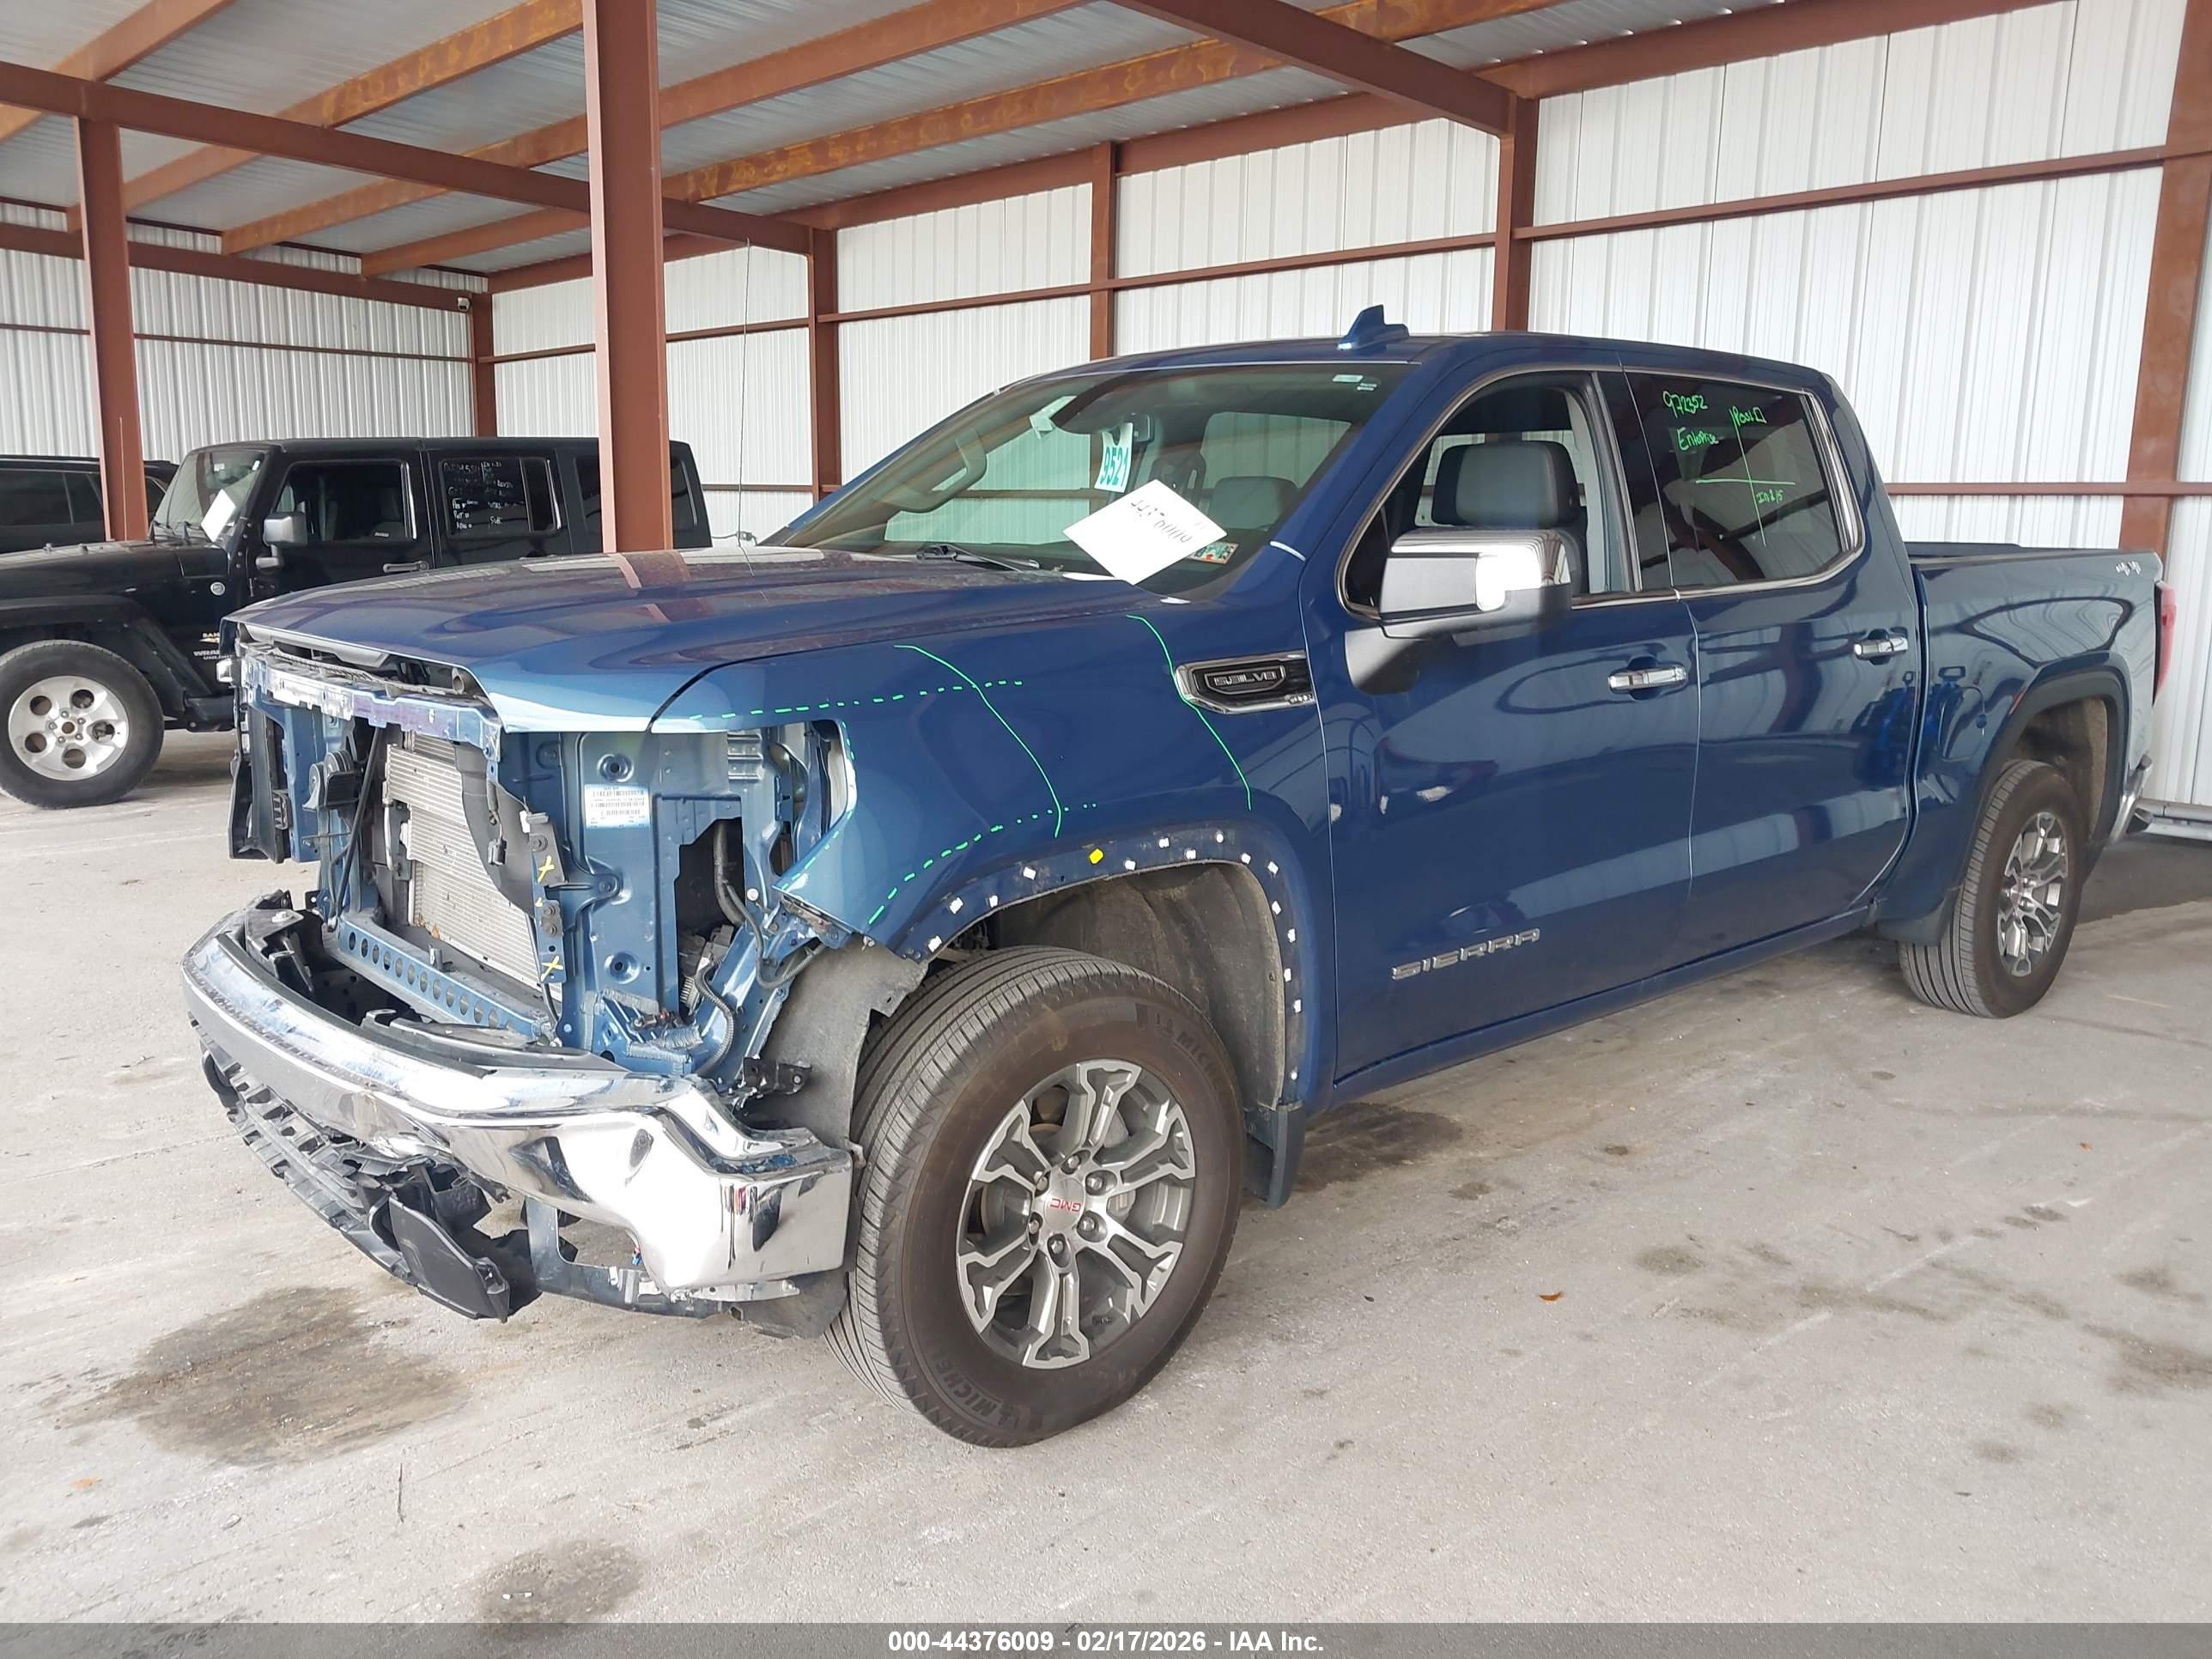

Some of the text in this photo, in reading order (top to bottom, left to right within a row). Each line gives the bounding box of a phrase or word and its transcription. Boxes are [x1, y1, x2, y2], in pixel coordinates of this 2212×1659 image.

[1662, 391, 1709, 419] 972352
[1099, 446, 1130, 489] 9521
[1391, 927, 1541, 981] SIERRA
[1049, 1197, 1082, 1212] GMC
